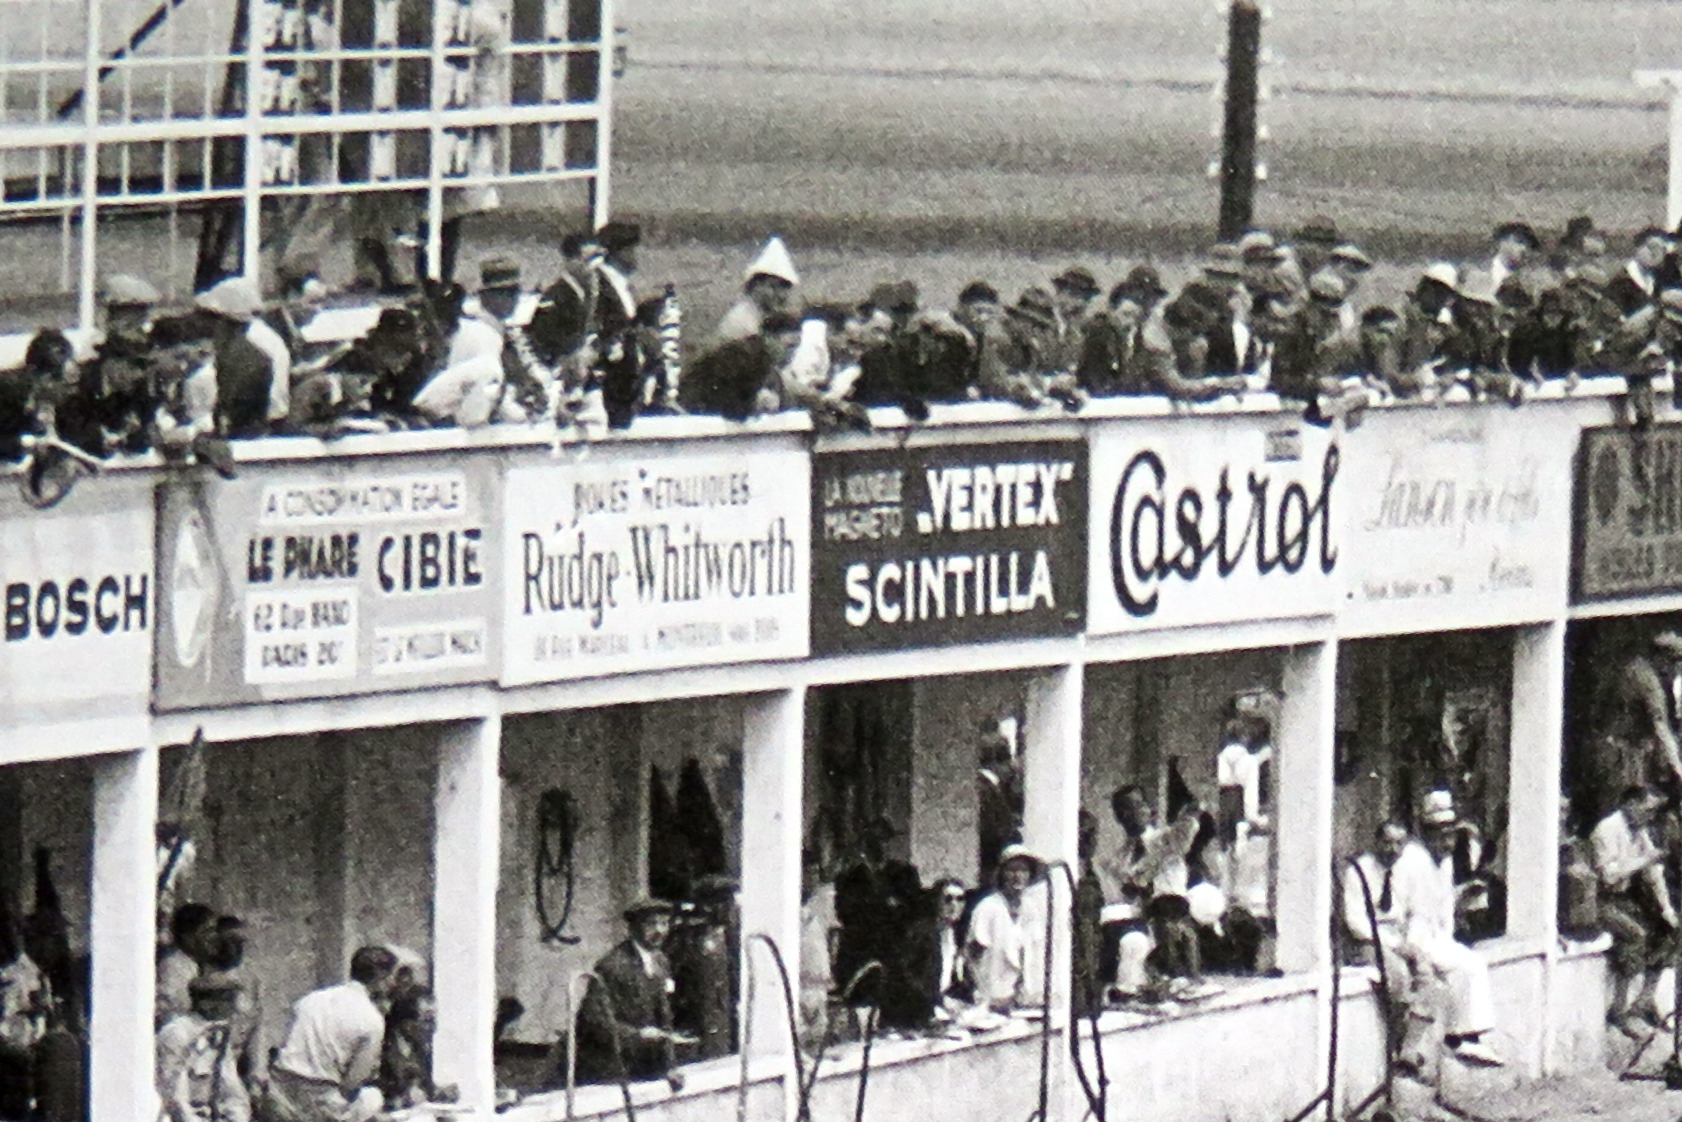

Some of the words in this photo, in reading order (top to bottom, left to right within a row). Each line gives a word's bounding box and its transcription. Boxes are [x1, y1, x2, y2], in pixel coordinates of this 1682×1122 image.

[247, 536, 275, 584] LE
[283, 531, 359, 581] PHARE
[1109, 443, 1340, 619] Castrol
[3, 573, 149, 642] BOSCH
[844, 548, 1056, 628] SCINTILLA
